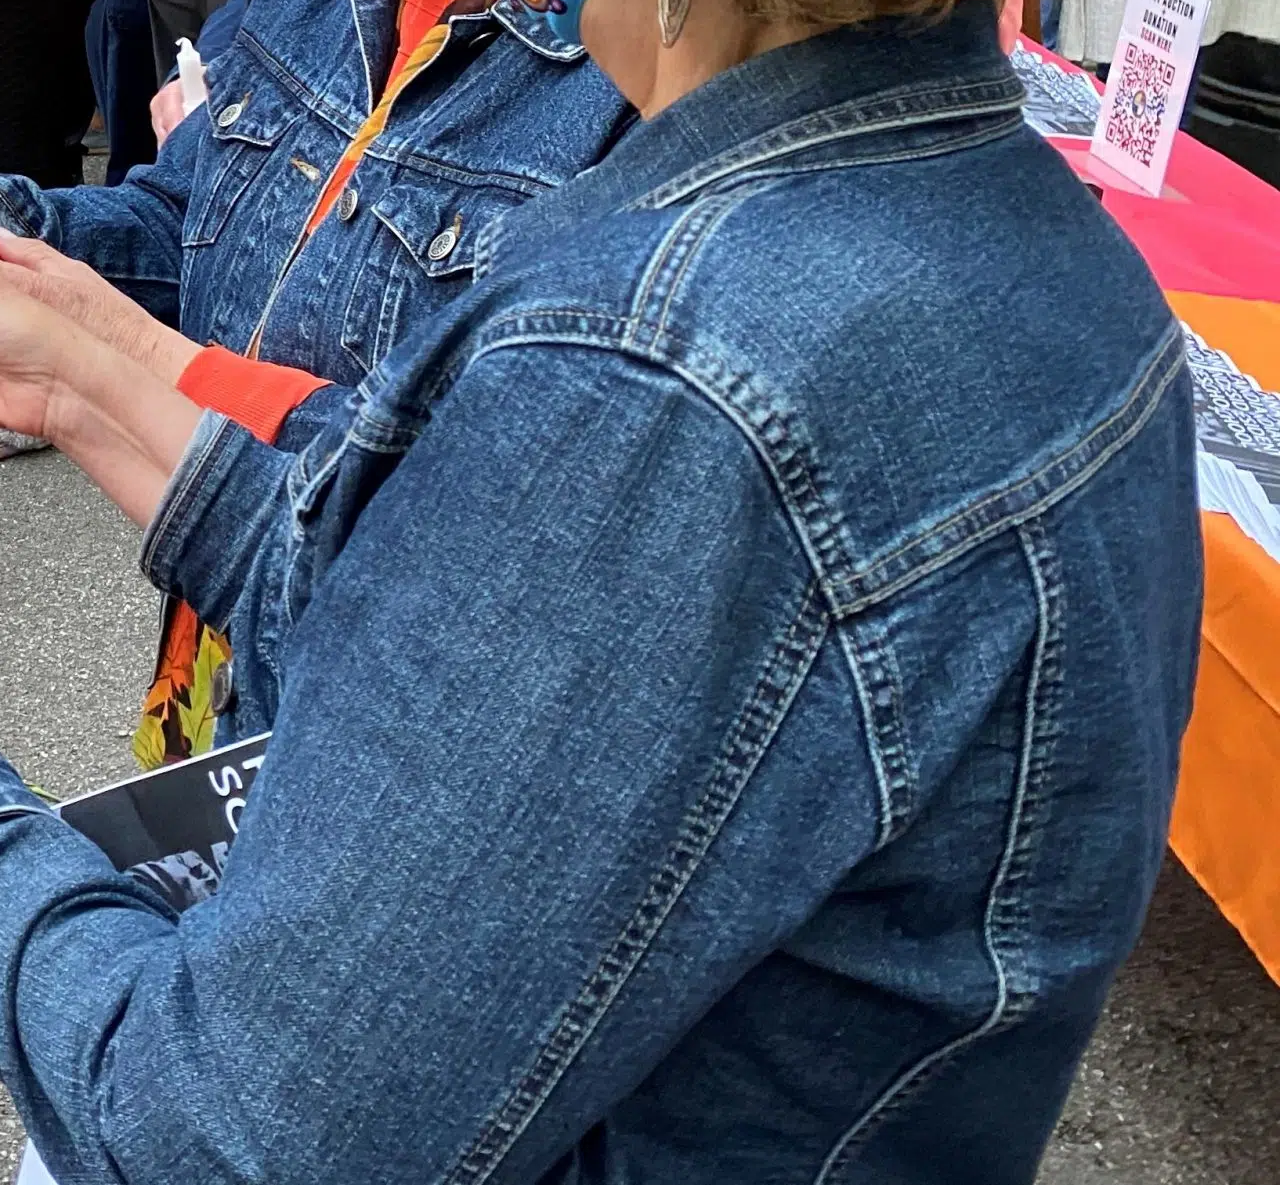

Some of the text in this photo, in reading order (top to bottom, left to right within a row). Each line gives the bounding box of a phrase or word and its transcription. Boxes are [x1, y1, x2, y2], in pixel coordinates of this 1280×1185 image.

[1143, 9, 1179, 38] DONATION
[1140, 26, 1173, 54] SCAN HERE
